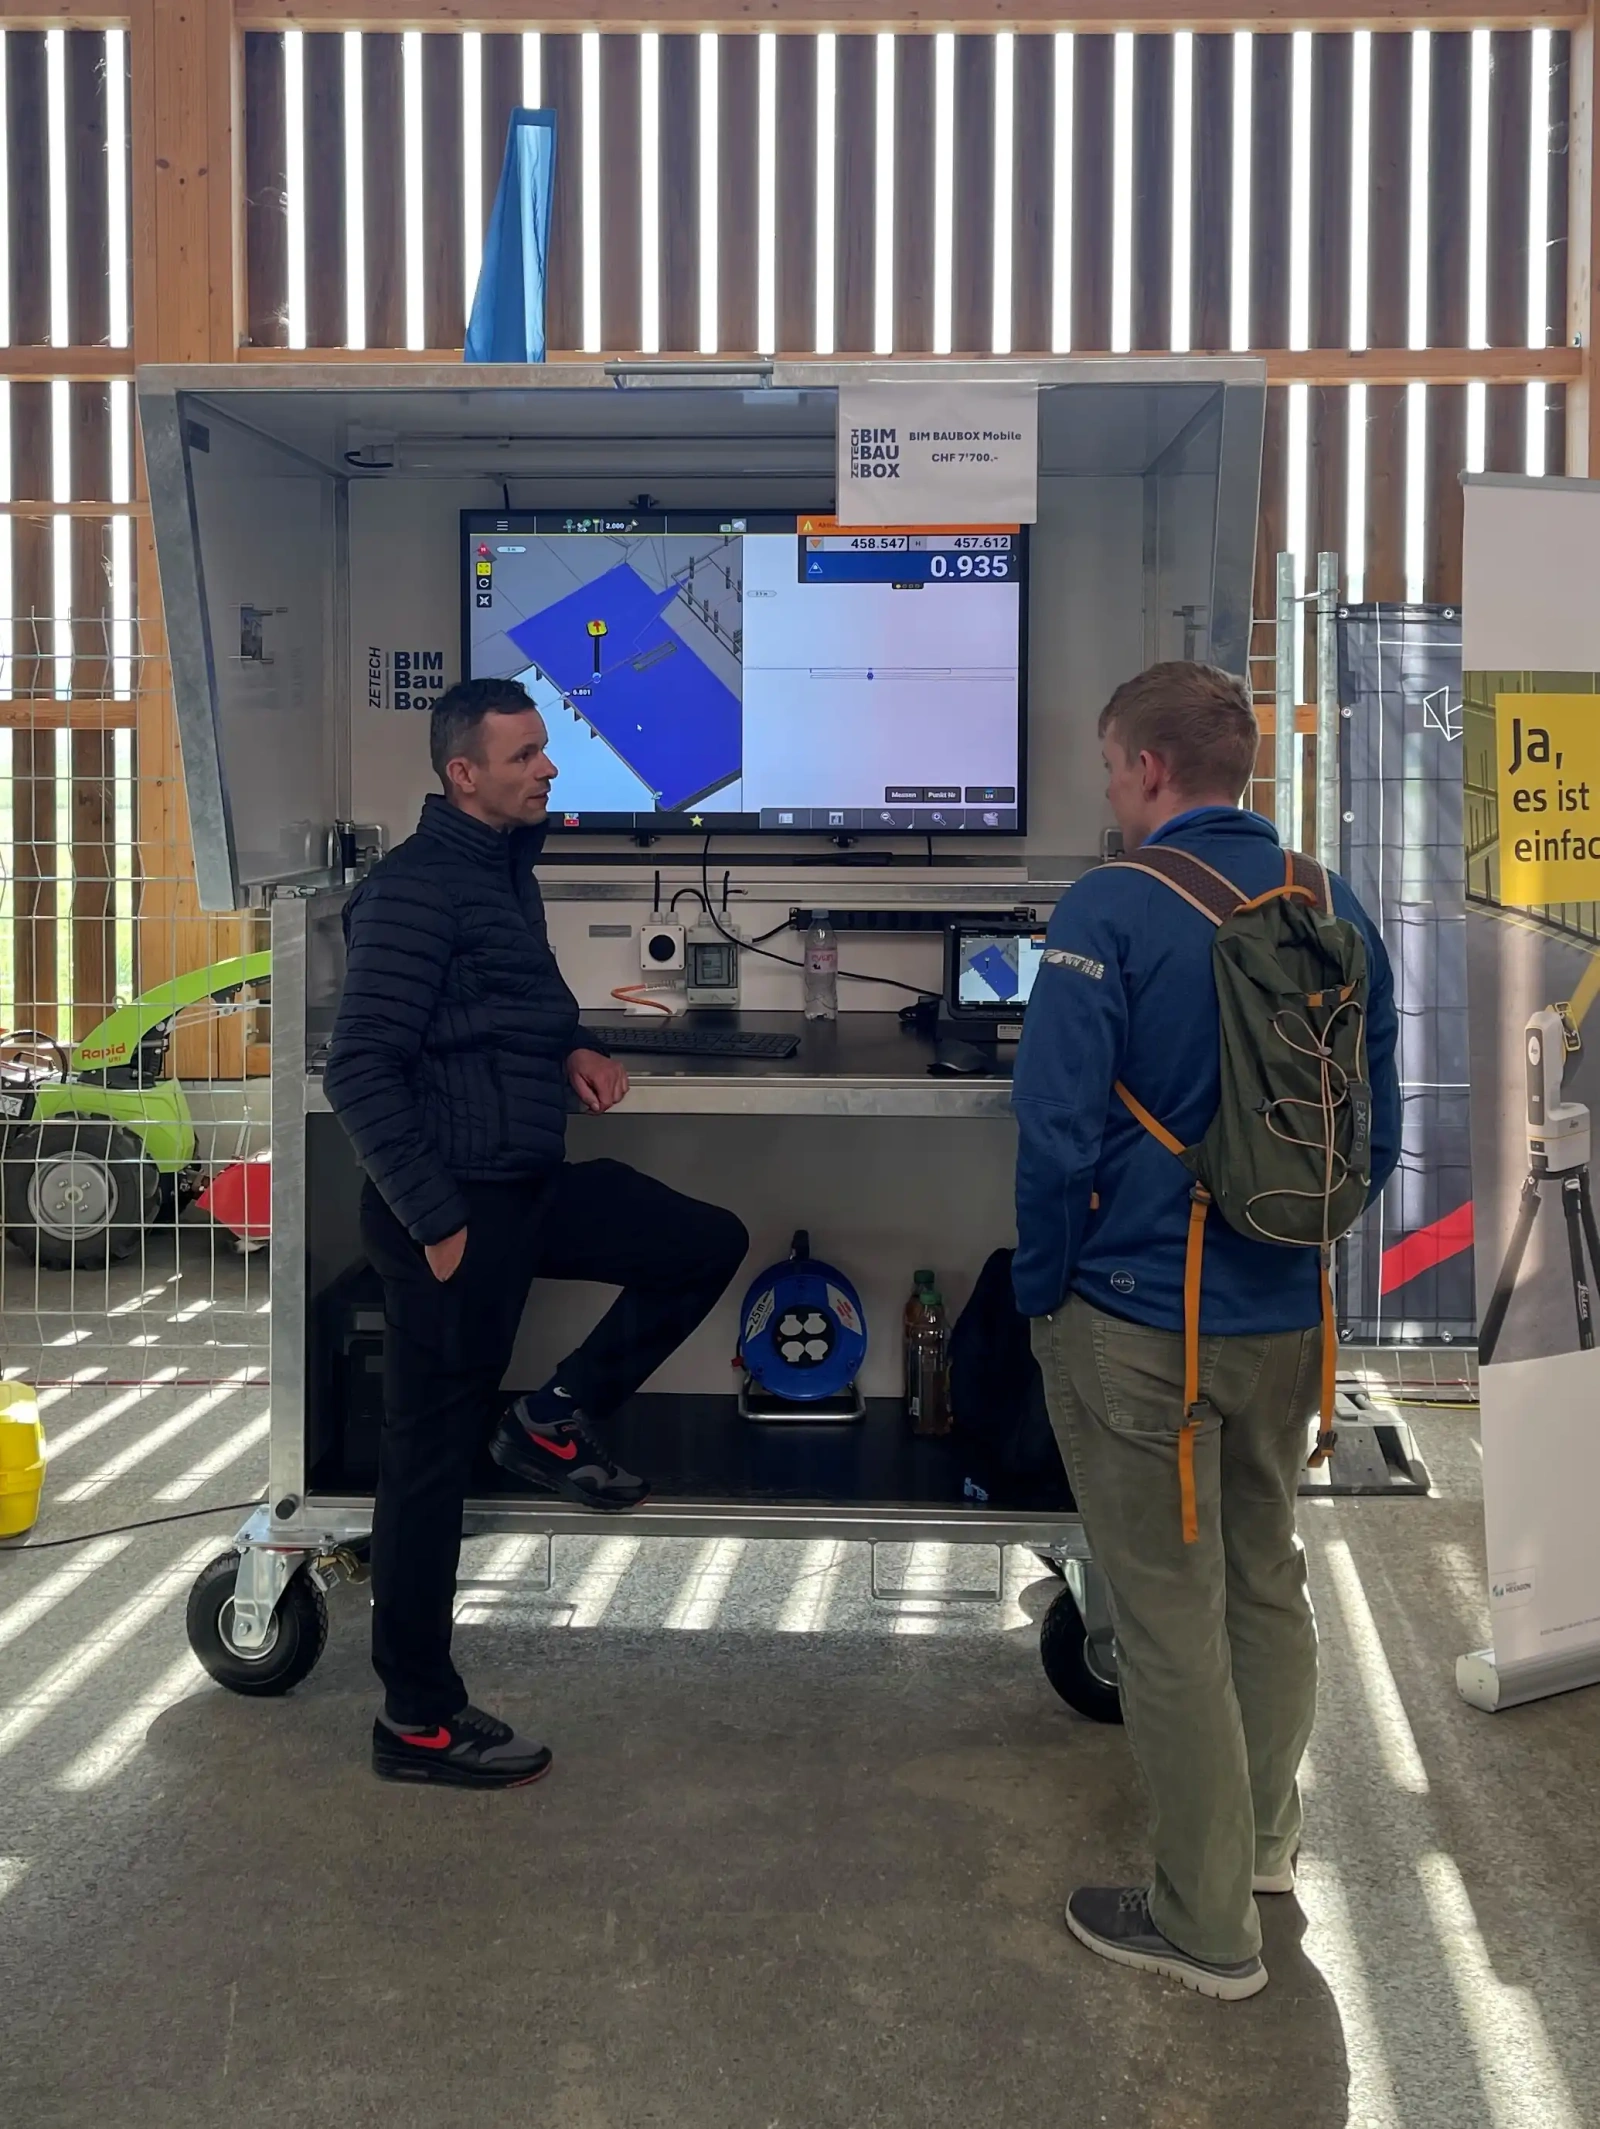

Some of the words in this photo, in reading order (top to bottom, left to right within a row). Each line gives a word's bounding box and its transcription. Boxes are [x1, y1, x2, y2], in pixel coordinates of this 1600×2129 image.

[861, 429, 896, 443] BIM
[909, 432, 930, 441] BIM
[933, 432, 980, 441] BAUBOX
[983, 431, 1022, 440] Mobile
[861, 445, 899, 460] BAU
[932, 453, 956, 462] CHF
[958, 453, 998, 462] 7'700.-
[861, 463, 900, 478] BOX
[605, 522, 625, 530] 2.000
[850, 538, 906, 549] 458.547
[953, 537, 1009, 549] 457.612
[930, 555, 1008, 578] 0.935
[394, 651, 443, 670] BIM
[369, 646, 381, 709] ZETECH
[394, 670, 443, 689] Bau
[1508, 718, 1563, 775] Ja,
[1513, 788, 1547, 813] es
[1558, 779, 1590, 812] ist
[81, 1042, 126, 1060] Rapid
[1355, 1100, 1367, 1152] EXPED
[750, 1311, 761, 1325] 25
[757, 1303, 766, 1313] m
